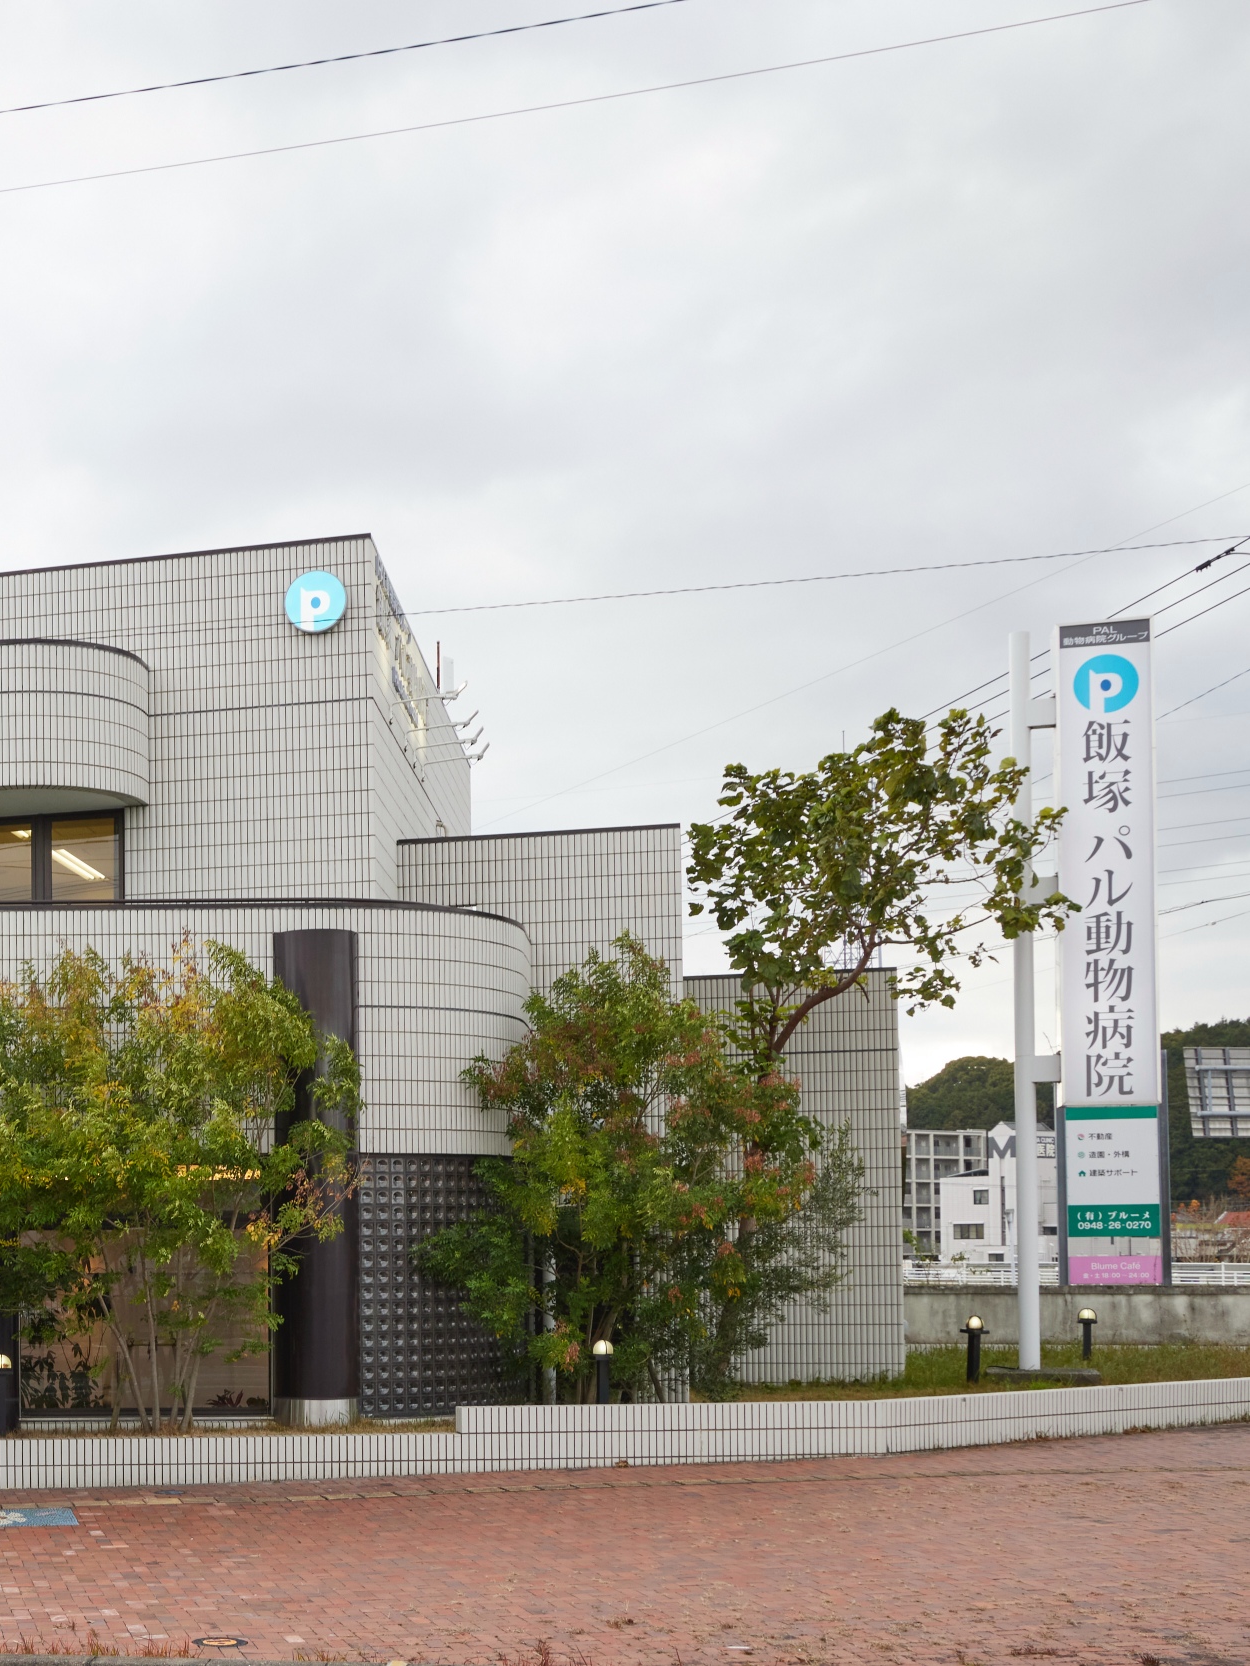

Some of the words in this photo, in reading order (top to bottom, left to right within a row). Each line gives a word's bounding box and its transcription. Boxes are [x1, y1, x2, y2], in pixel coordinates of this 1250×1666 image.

[1093, 626, 1117, 635] PAL
[1063, 631, 1148, 646] 動物病院グループ
[1089, 1169, 1138, 1177] 建築サポート
[1077, 1221, 1152, 1230] 0948-26-0270
[1091, 1262, 1118, 1270] Blume
[1120, 1261, 1141, 1270] Café
